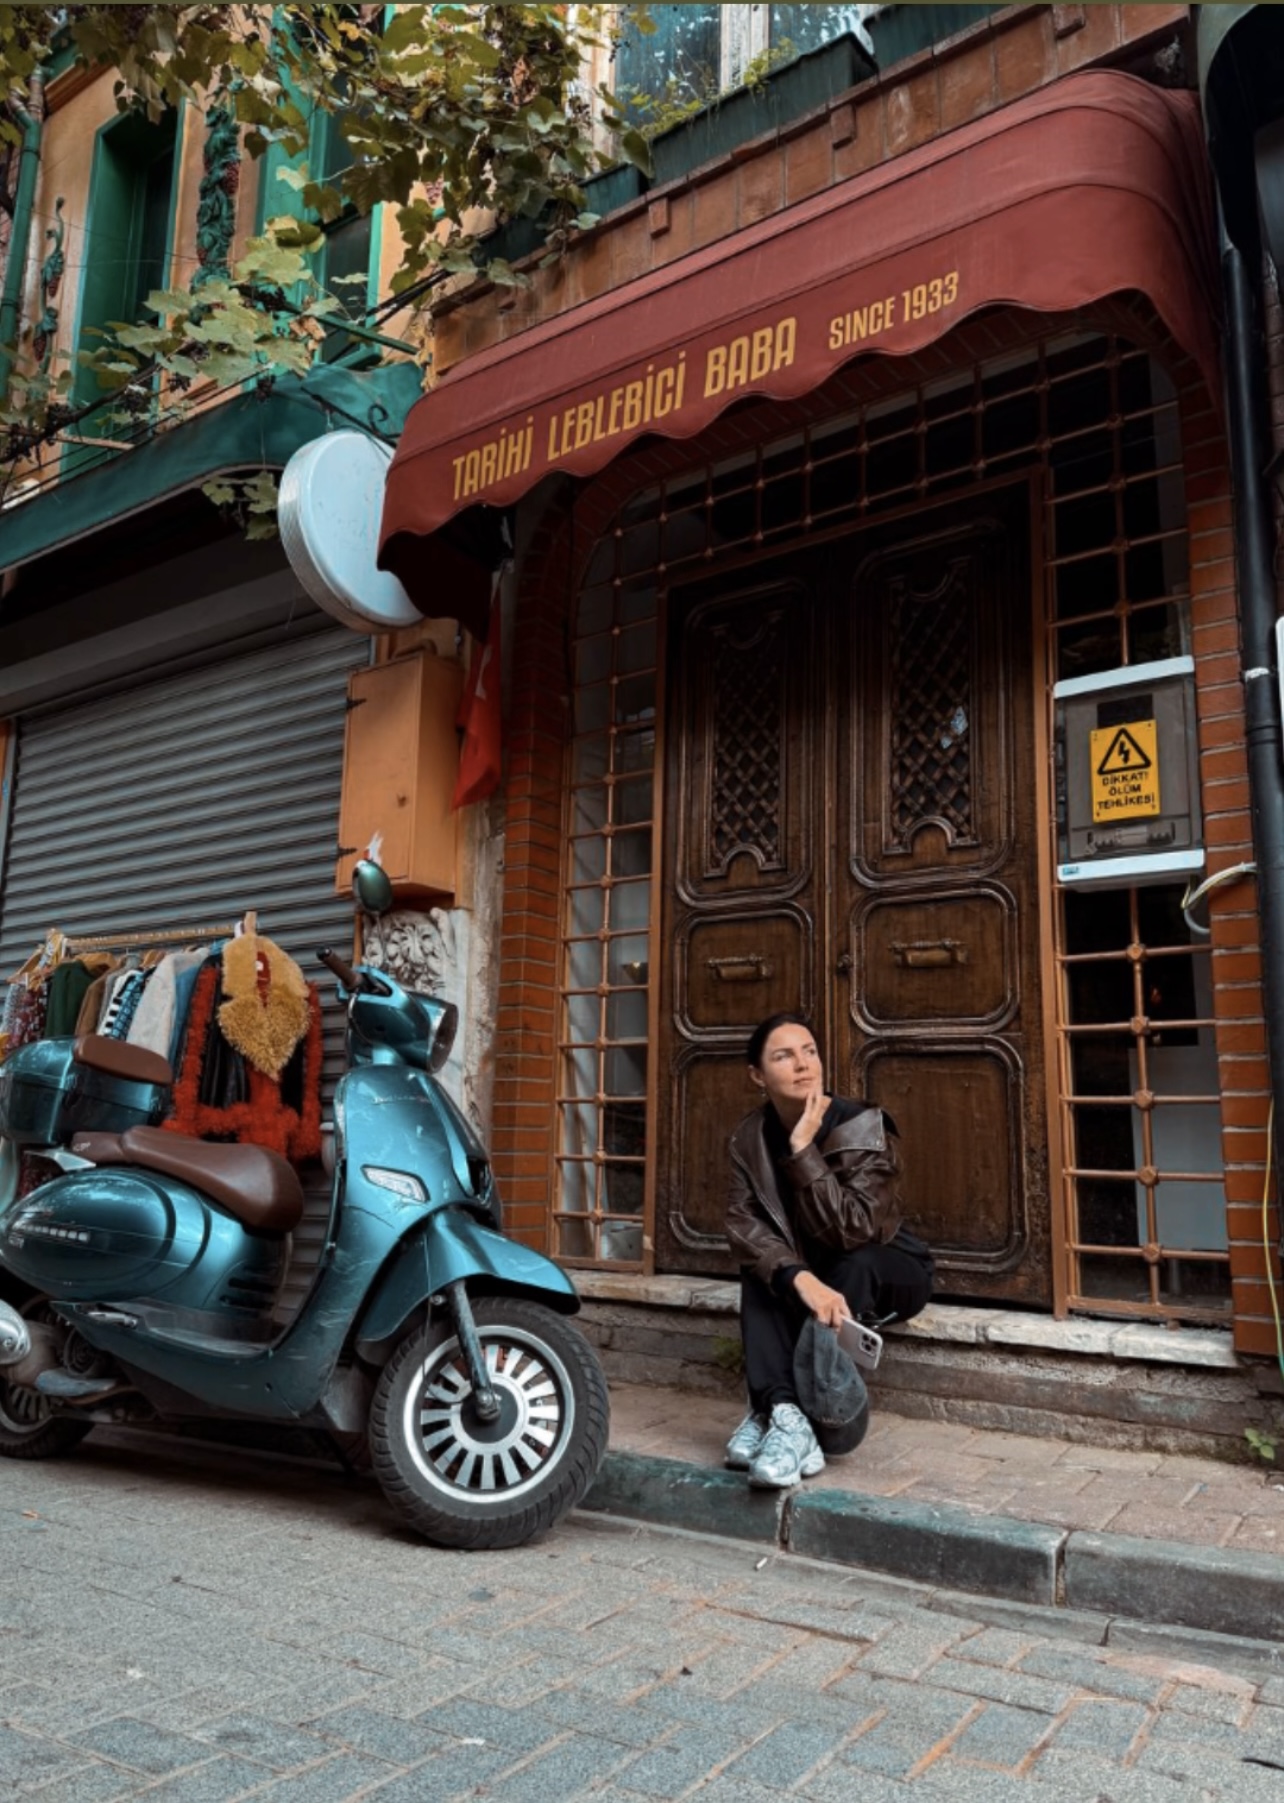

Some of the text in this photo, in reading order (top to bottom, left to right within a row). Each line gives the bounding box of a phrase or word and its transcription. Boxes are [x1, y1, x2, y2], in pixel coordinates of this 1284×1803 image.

[453, 271, 959, 500] TARİHİ LEBLEBİCİ BABA SINCE 1933
